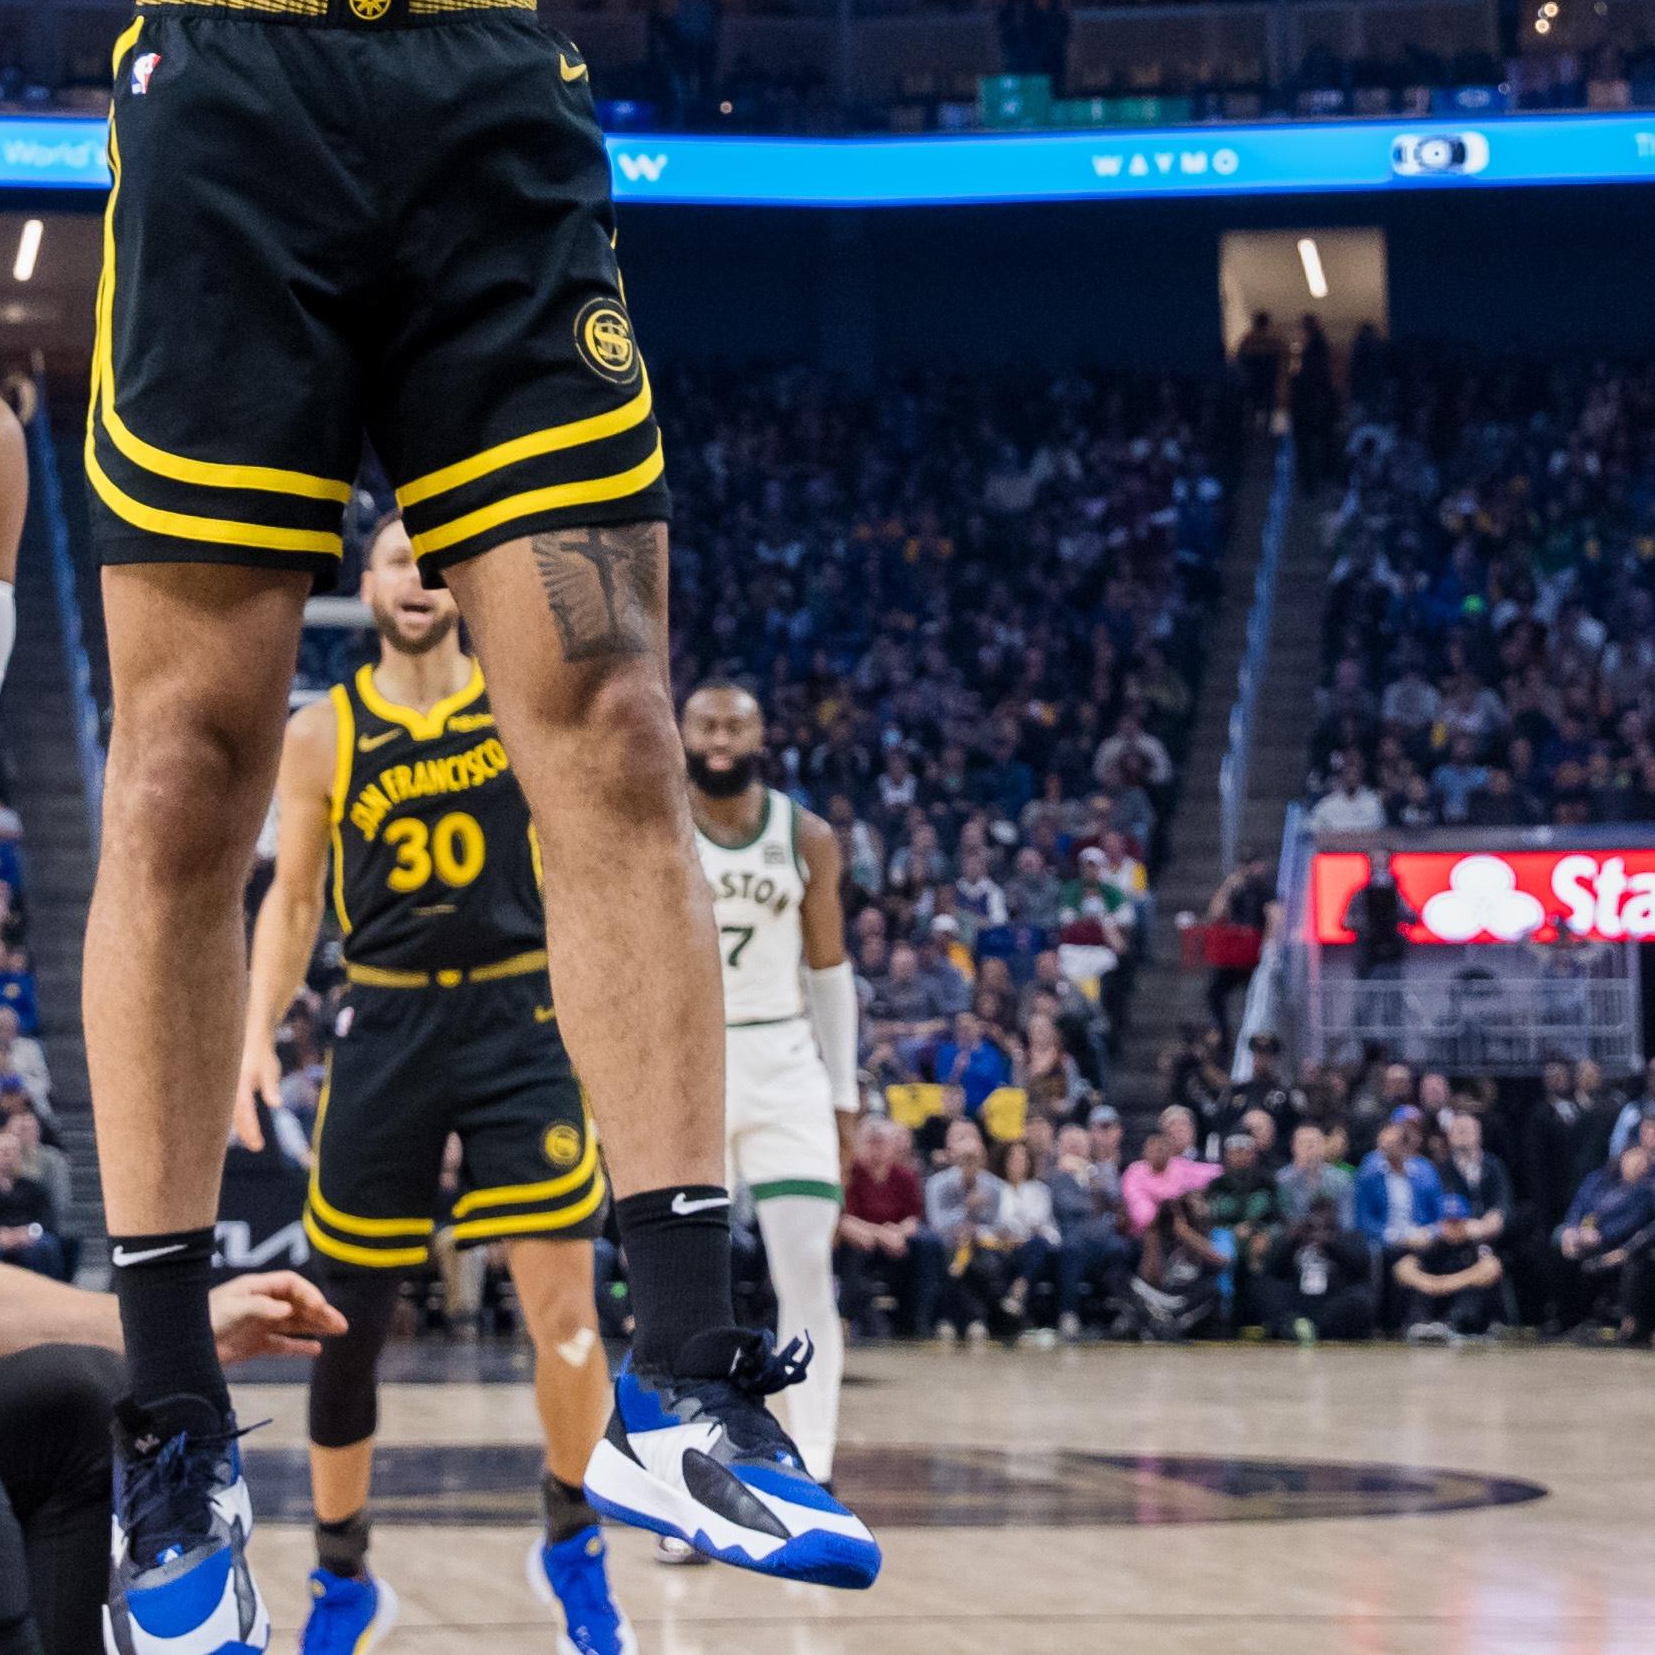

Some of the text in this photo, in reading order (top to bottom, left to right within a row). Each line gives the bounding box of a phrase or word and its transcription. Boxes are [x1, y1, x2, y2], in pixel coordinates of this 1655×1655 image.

[1092, 149, 1239, 178] WAYMO
[350, 738, 508, 843] SAN FRANCISCO
[383, 810, 486, 893] 30
[714, 872, 790, 917] STON
[720, 925, 754, 967] 7
